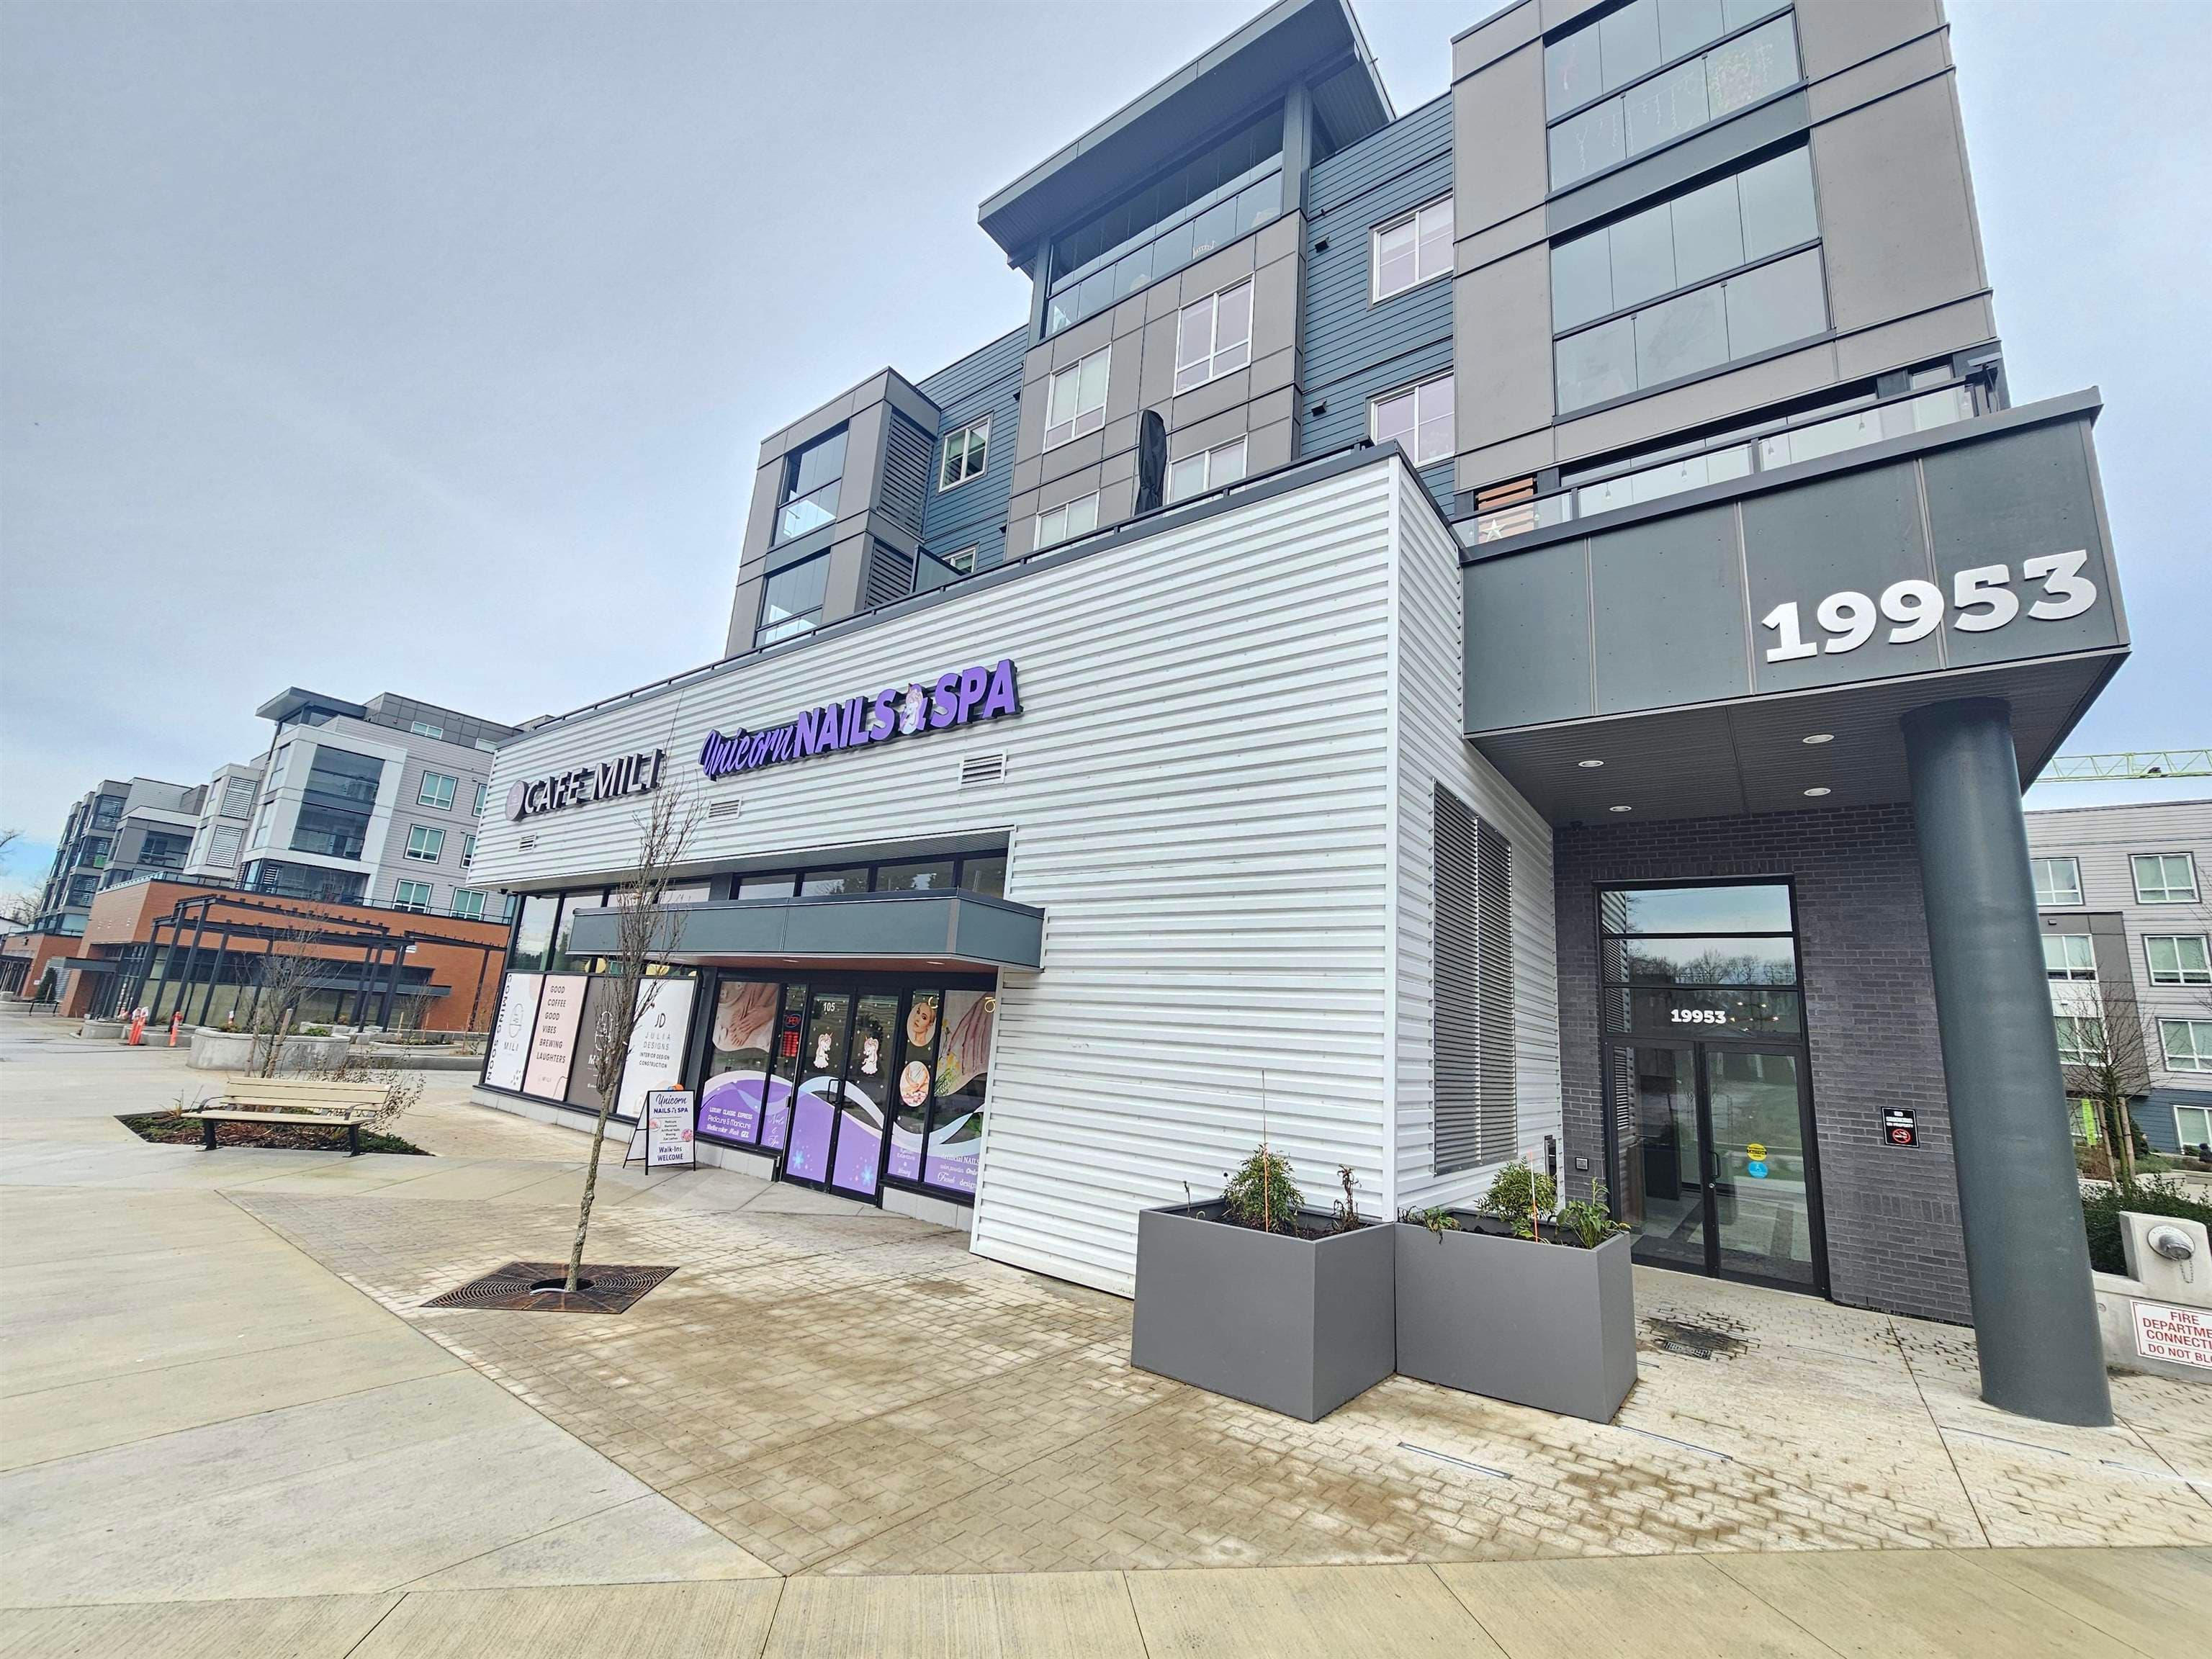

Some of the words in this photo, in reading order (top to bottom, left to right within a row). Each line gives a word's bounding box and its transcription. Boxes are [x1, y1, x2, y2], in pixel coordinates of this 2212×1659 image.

[1761, 549, 2098, 662] 19953
[699, 727, 796, 781] Unicorn
[793, 688, 899, 757] NAILS
[930, 659, 1020, 729] SPA
[524, 768, 587, 814] CAFE
[590, 748, 662, 801] MILI
[497, 974, 512, 1033] COMING
[547, 999, 567, 1007] COFFEE
[823, 1002, 835, 1012] 105
[544, 1012, 560, 1020] GOOD
[654, 1013, 666, 1028] JD
[1671, 1008, 1727, 1024] 19953
[542, 1025, 557, 1034] VIBES
[644, 1032, 672, 1041] JULIA
[503, 1041, 519, 1051] MILI
[539, 1038, 563, 1048] BREWING
[643, 1040, 670, 1051] DESIGNS
[486, 1040, 499, 1081] SOON
[536, 1052, 566, 1064] LAUGHTERS
[655, 1094, 687, 1108] Unicorn
[708, 1115, 727, 1124] Pedicure
[730, 1119, 751, 1129] Manicure
[2170, 1311, 2200, 1326] FIRE
[2143, 1318, 2212, 1339] DEPARTME
[2149, 1344, 2164, 1354] DO
[2168, 1347, 2191, 1359] NOT
